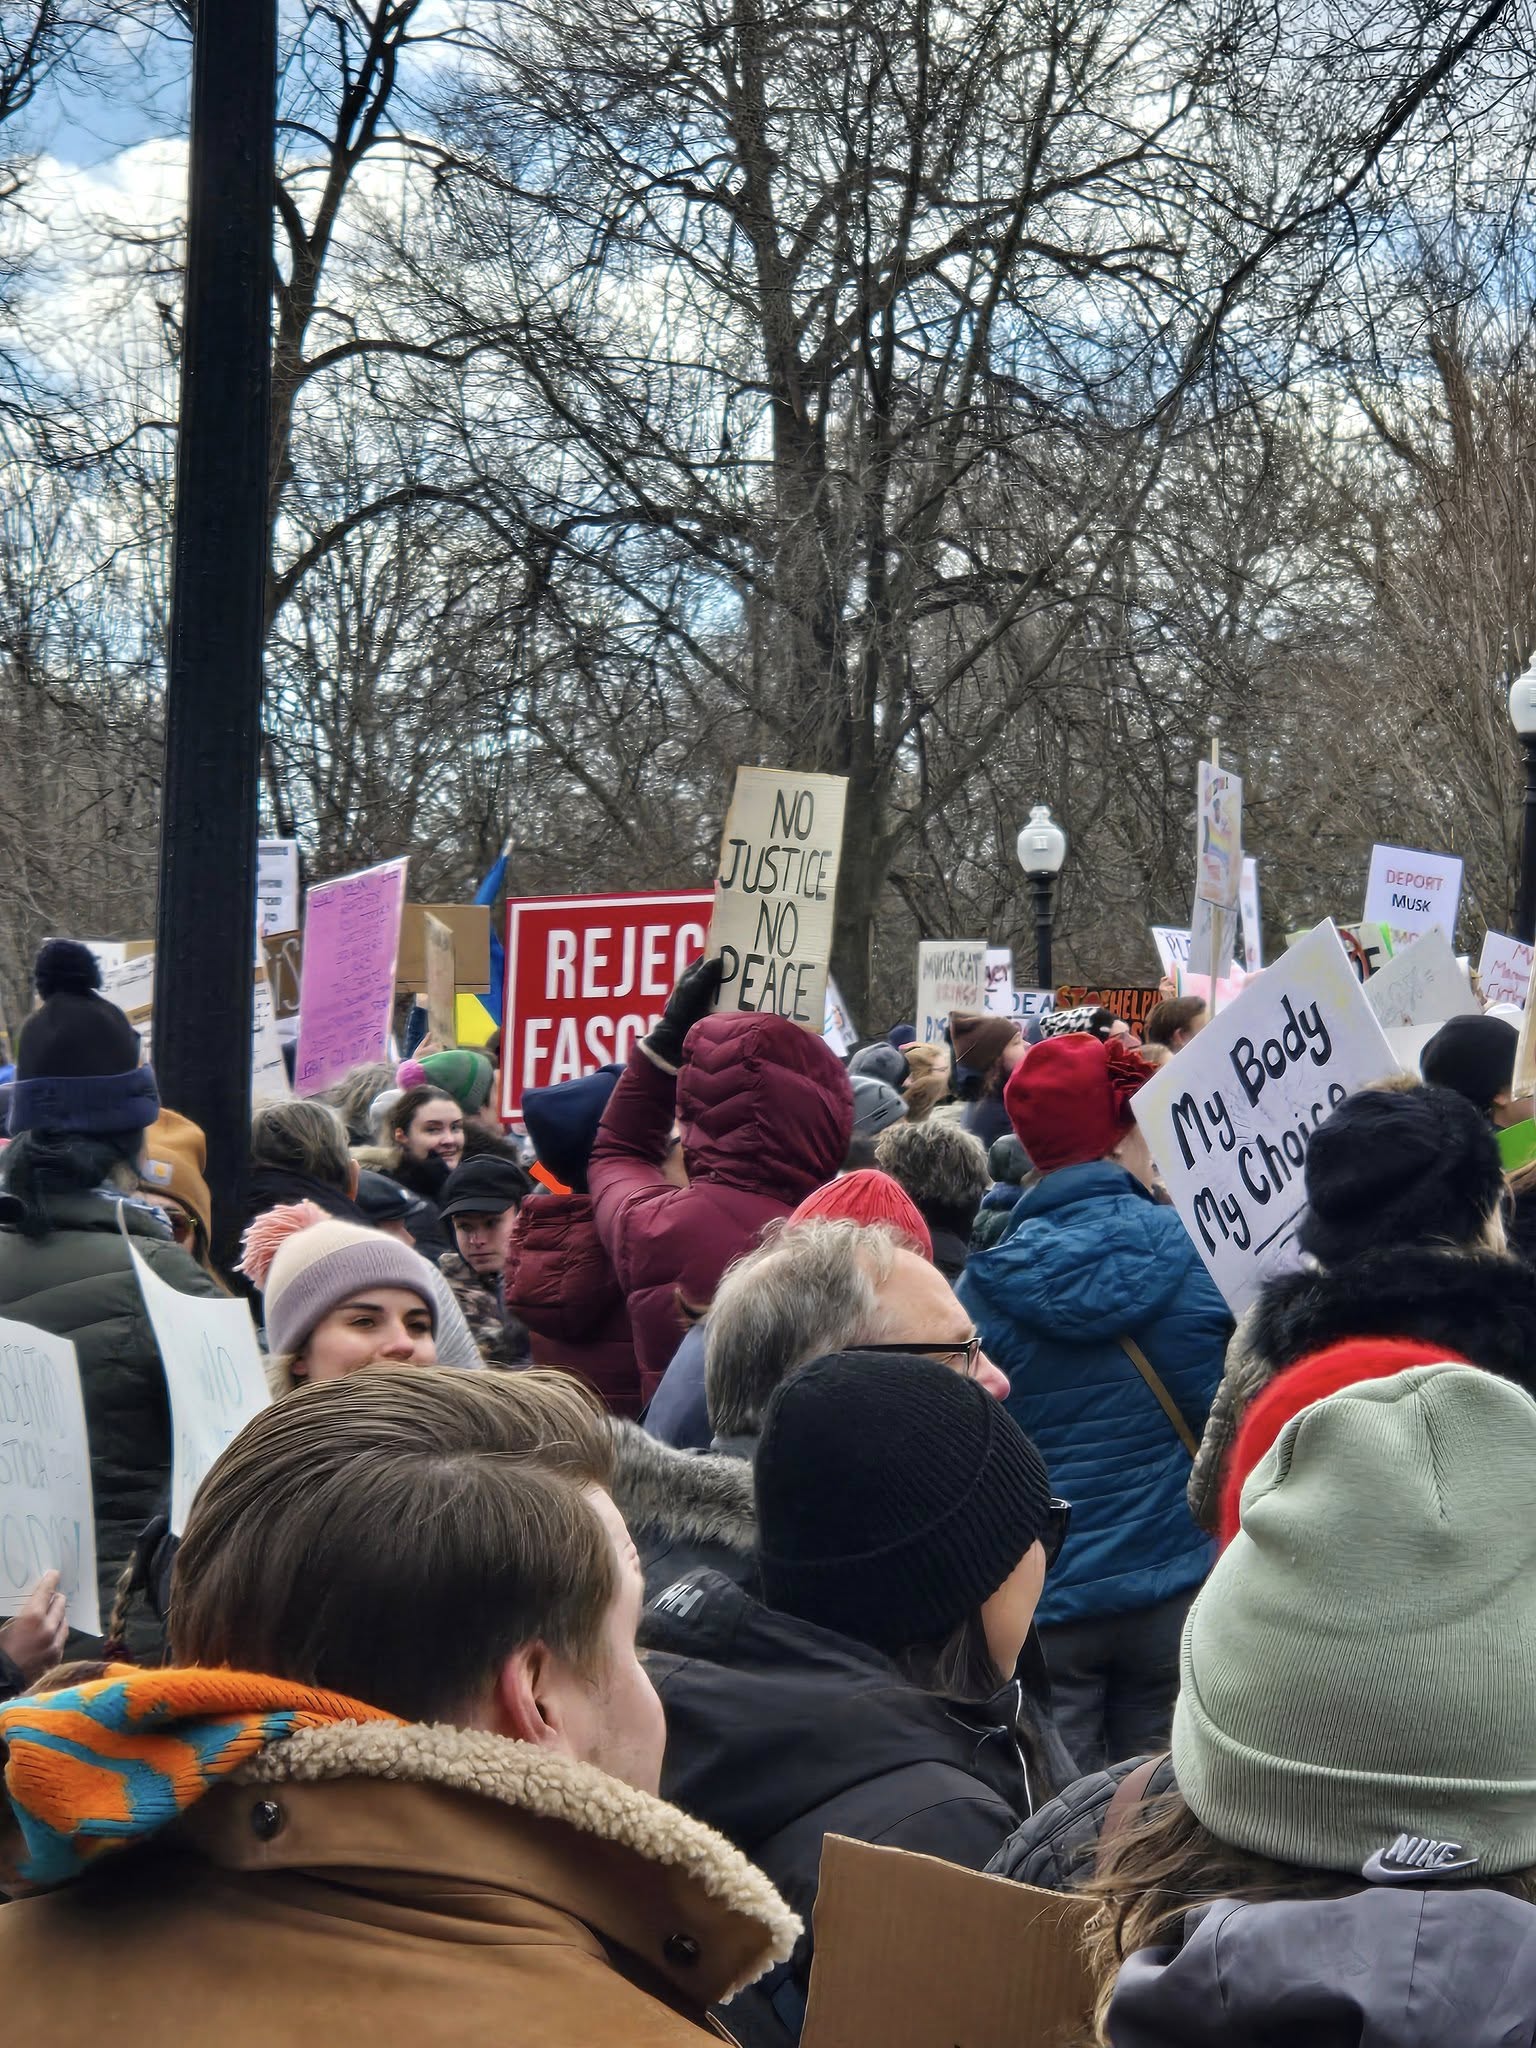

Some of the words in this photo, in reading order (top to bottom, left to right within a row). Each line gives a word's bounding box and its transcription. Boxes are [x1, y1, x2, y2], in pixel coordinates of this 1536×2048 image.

[770, 789, 815, 841] NO
[718, 838, 833, 901] JUSTICE
[1387, 869, 1444, 891] DEPORT
[754, 899, 799, 958] NO
[1391, 893, 1432, 912] MUSK
[545, 922, 706, 1000] REJEC
[713, 944, 816, 1022] PEACE
[522, 1013, 664, 1090] FASC
[1171, 1091, 1237, 1171] My
[1229, 994, 1333, 1108] Body
[1193, 1186, 1252, 1258] My
[1238, 1083, 1348, 1206] Choice
[1384, 1832, 1463, 1869] NIKE
